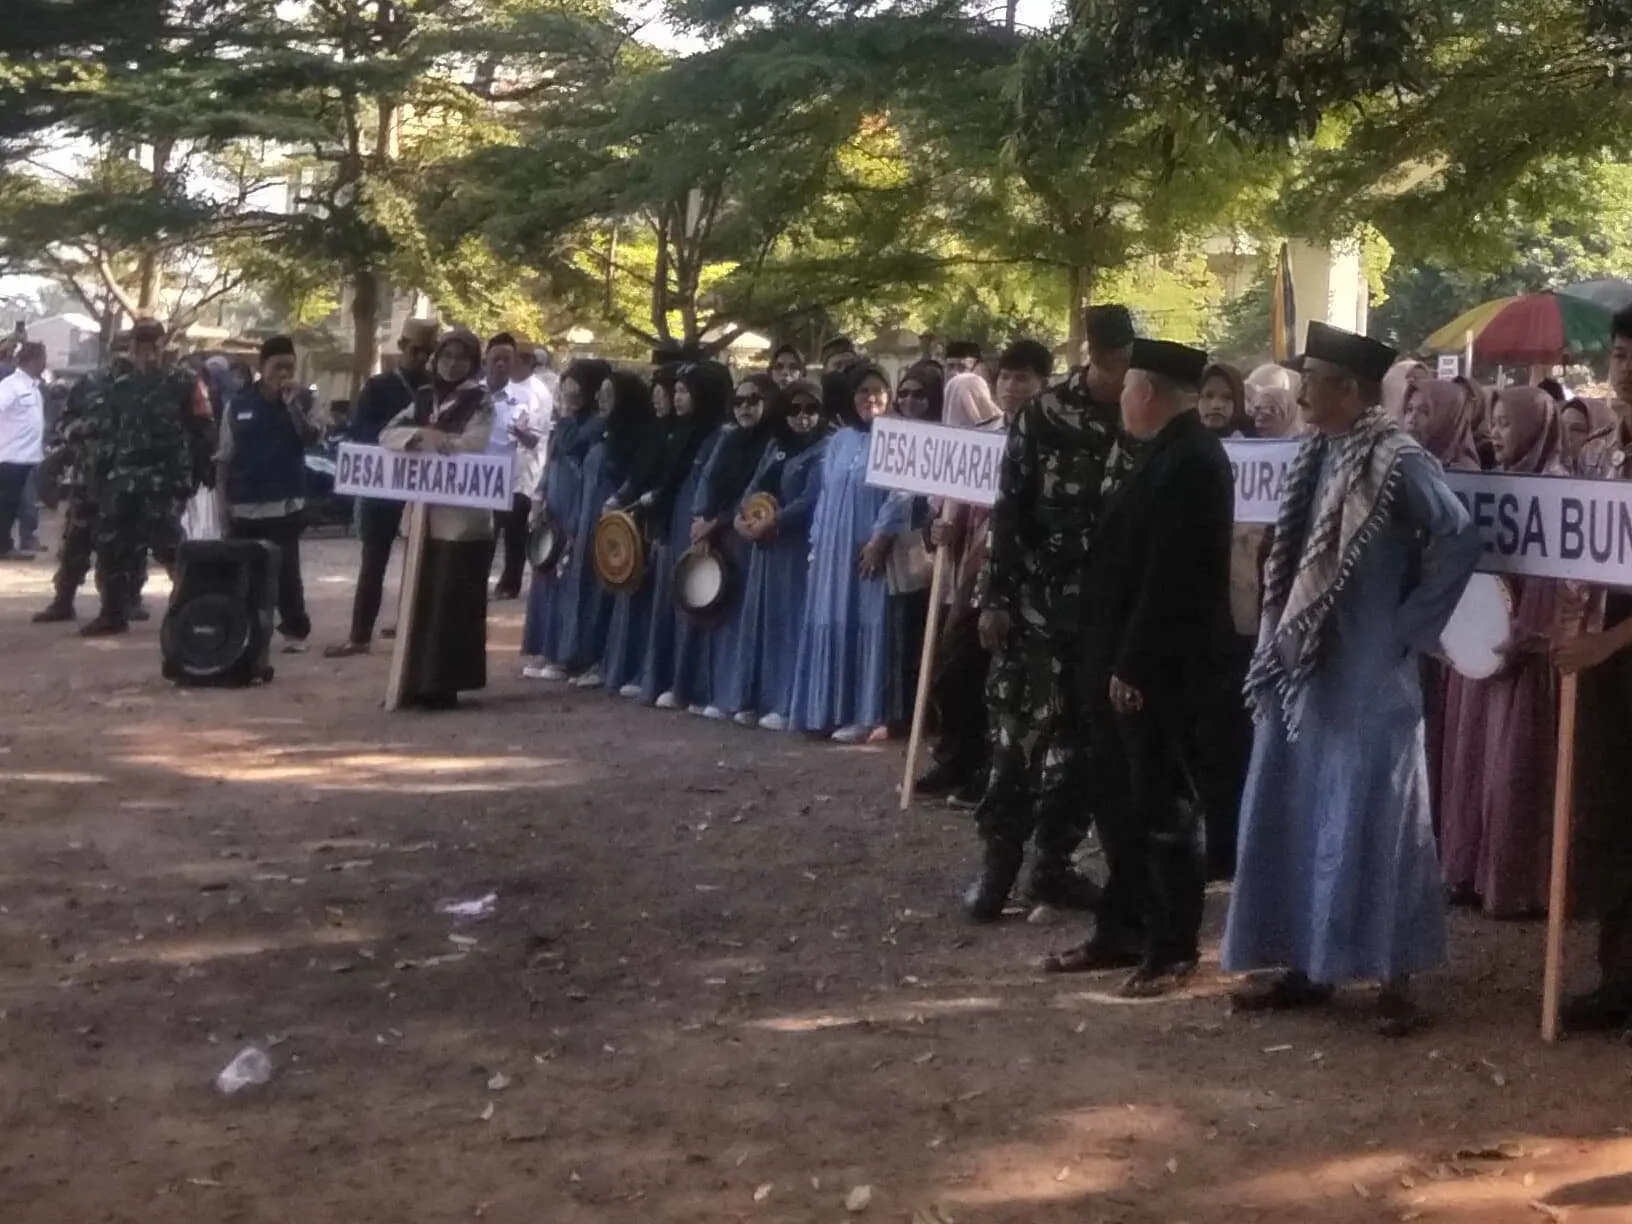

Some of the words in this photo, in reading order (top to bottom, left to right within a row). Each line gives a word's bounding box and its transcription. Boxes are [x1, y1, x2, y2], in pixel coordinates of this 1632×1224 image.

[340, 452, 384, 488] DESA
[391, 457, 504, 499] MEKARJAYA
[873, 429, 916, 477] DESA
